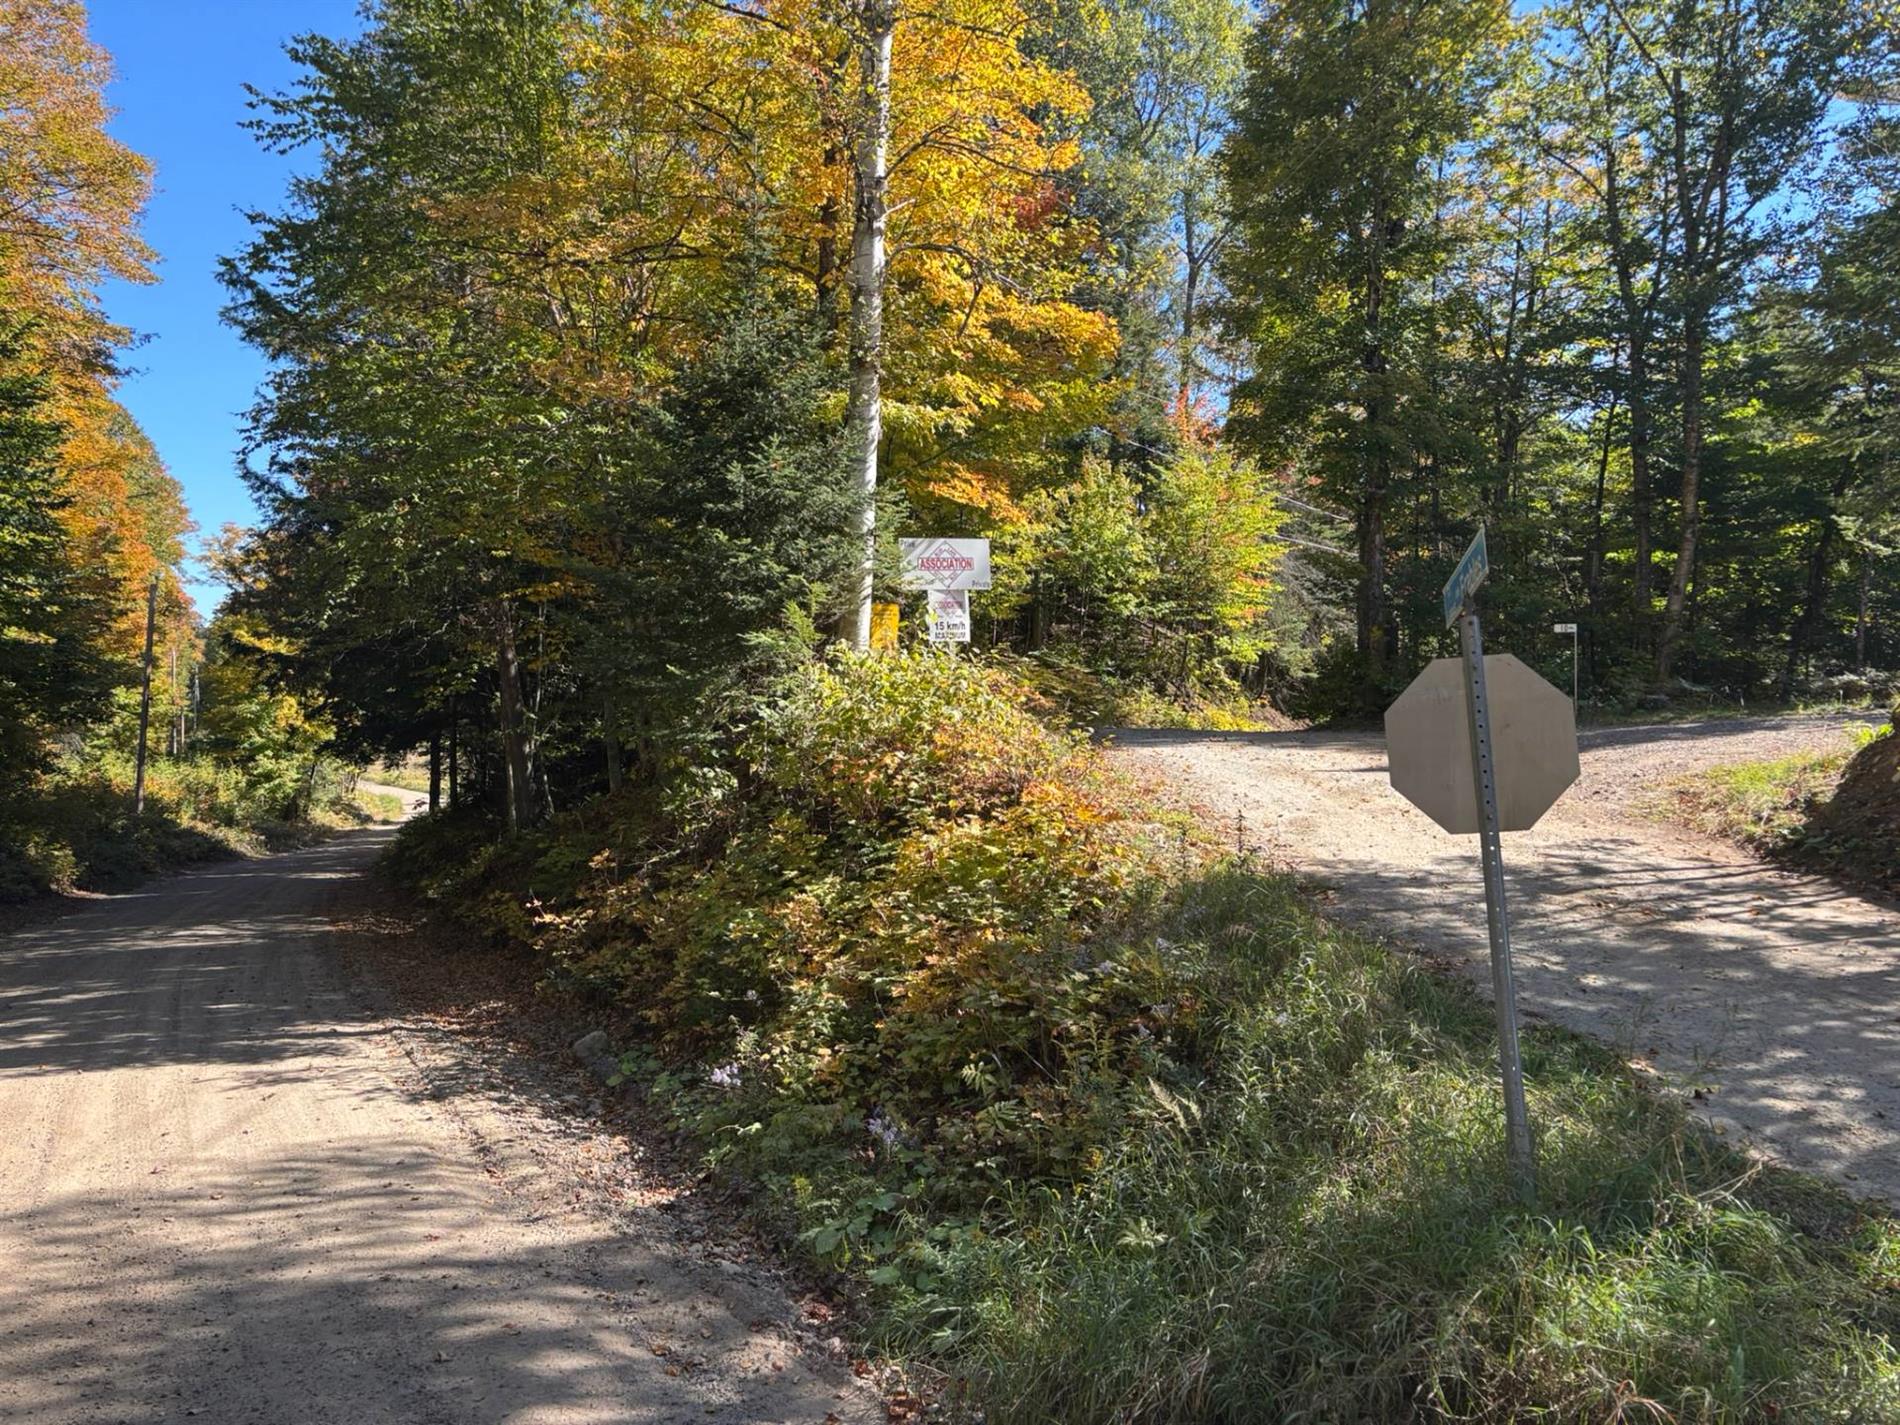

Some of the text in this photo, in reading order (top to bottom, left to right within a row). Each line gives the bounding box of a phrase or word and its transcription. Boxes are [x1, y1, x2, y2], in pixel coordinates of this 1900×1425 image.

[920, 558, 972, 569] ASSOCIATION
[934, 621, 966, 631] 15 km/h
